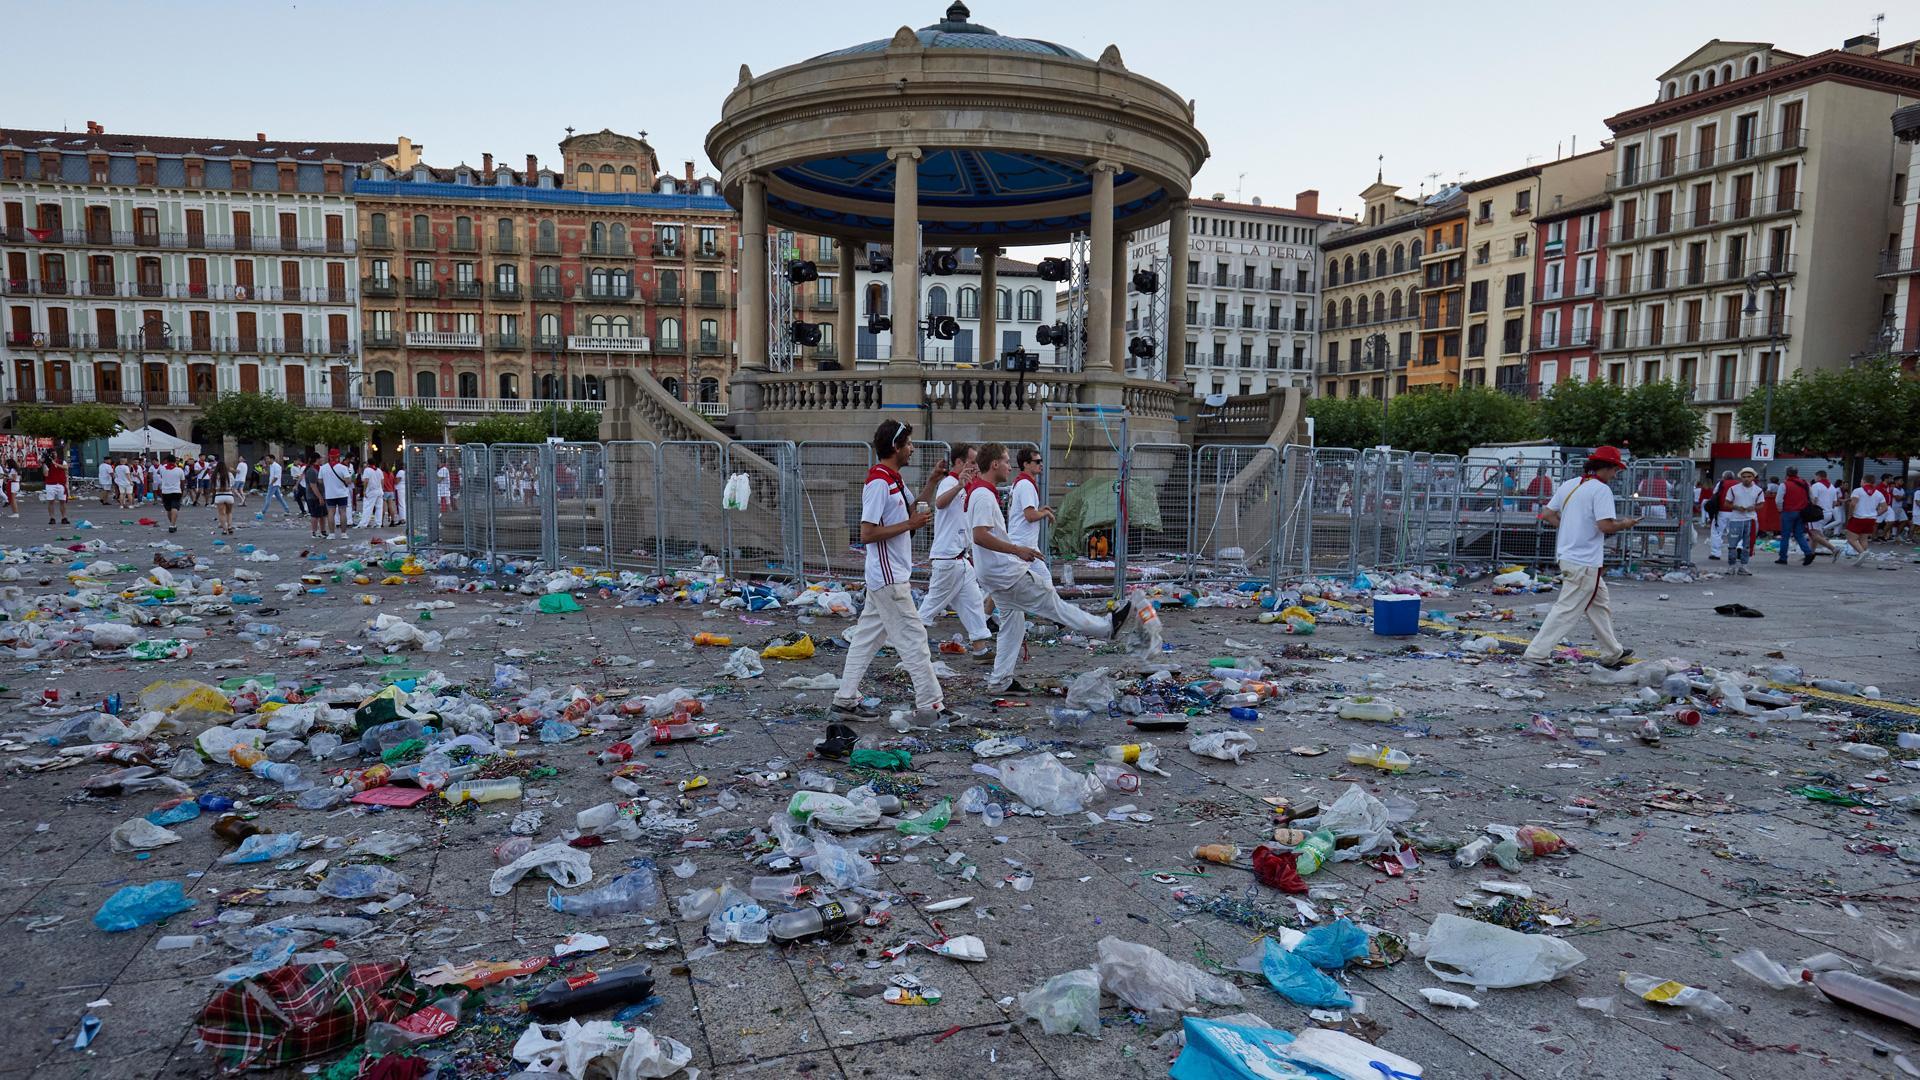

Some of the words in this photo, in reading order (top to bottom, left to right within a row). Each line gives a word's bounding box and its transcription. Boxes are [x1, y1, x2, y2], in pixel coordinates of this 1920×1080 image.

[1132, 241, 1160, 259] HOTEL
[1240, 243, 1260, 256] LA
[1268, 245, 1314, 261] PERLA
